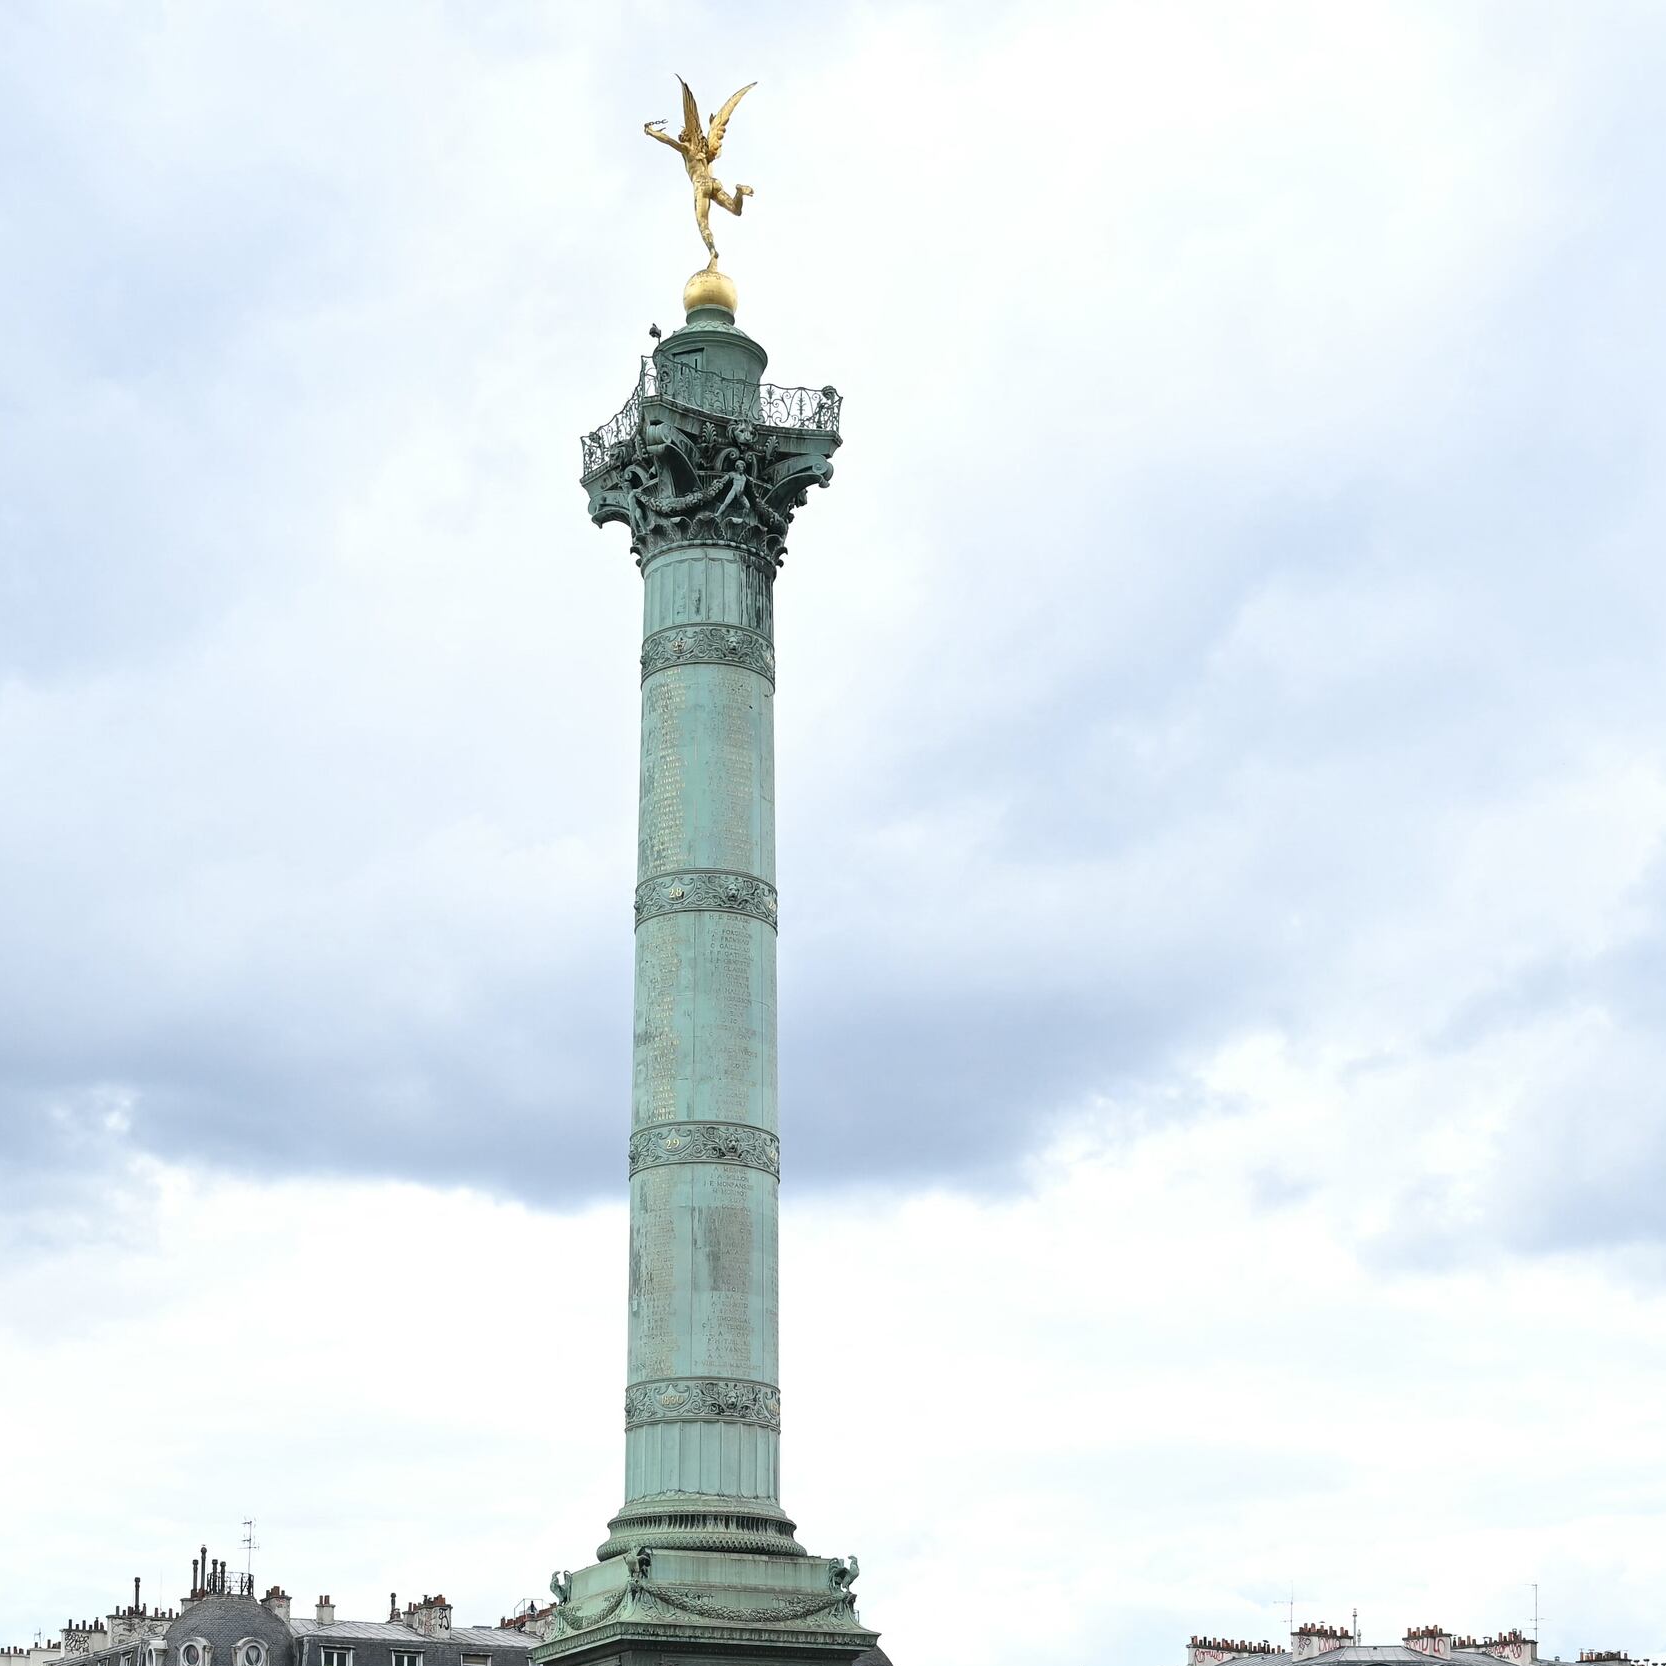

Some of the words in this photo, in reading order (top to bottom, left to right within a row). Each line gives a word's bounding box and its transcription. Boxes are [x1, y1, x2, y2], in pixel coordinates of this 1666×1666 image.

[669, 887, 683, 898] 28
[666, 1138, 680, 1149] 29
[661, 1394, 685, 1406] 1830
